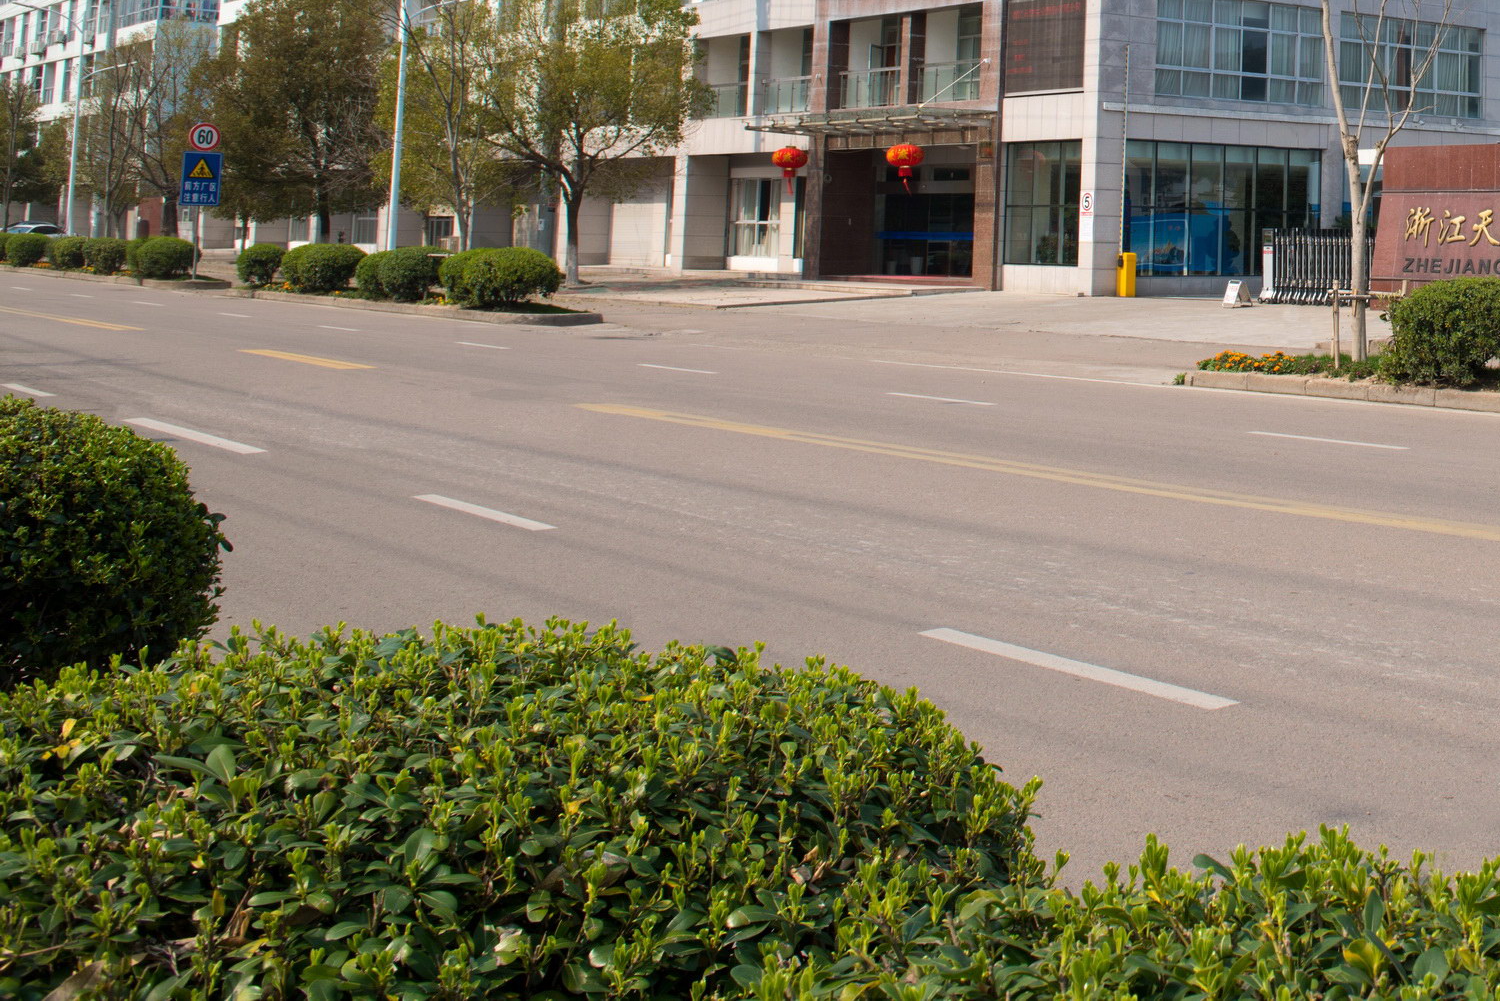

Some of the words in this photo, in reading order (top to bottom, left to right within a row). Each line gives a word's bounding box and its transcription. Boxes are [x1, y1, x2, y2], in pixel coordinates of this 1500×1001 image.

[198, 129, 213, 145] 60
[183, 193, 215, 203] 注意行人
[1084, 196, 1090, 209] 5
